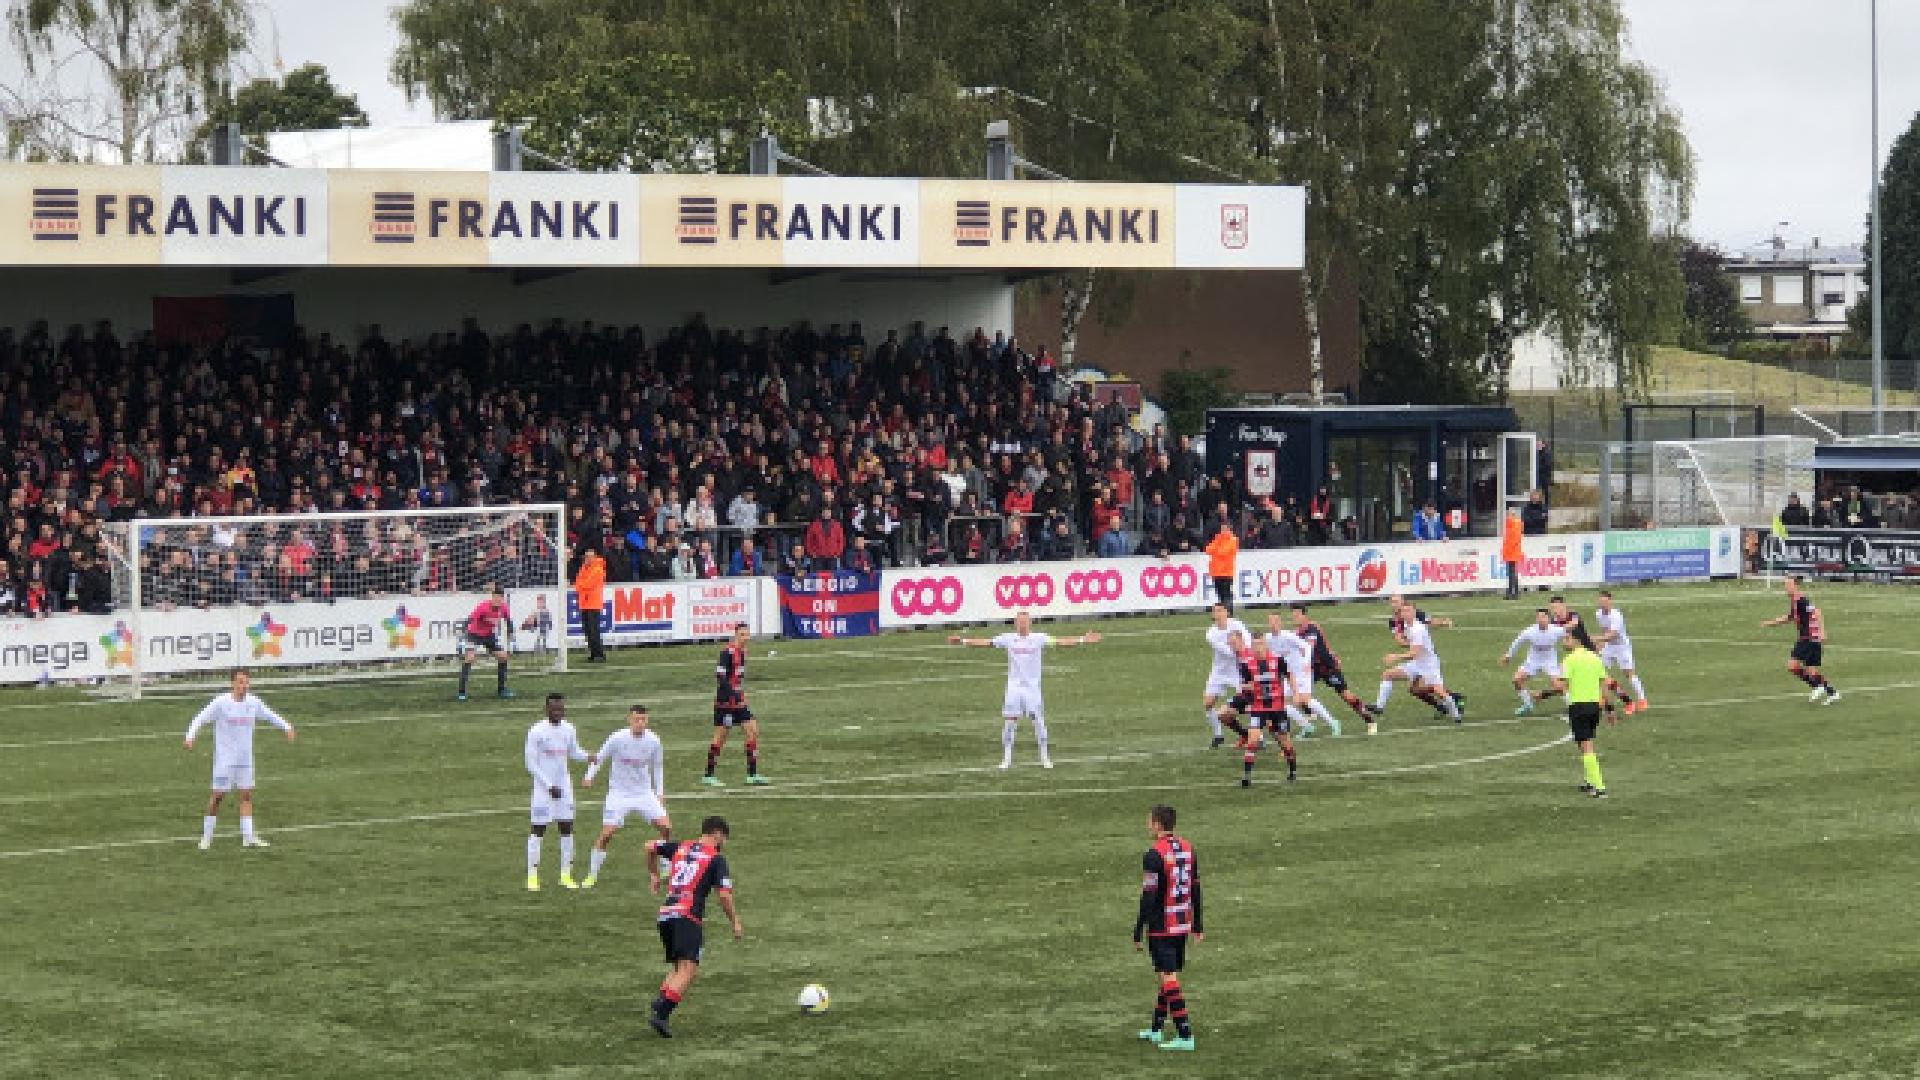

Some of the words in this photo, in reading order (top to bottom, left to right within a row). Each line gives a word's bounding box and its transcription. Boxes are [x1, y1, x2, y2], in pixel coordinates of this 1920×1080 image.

[95, 194, 306, 236] FRANKI
[428, 200, 619, 239] FRANKI
[731, 203, 901, 241] FRANKI
[1001, 206, 1158, 244] FRANKI
[792, 575, 858, 591] SERGIO
[812, 599, 838, 613] ON
[293, 625, 373, 654] mega
[800, 617, 847, 634] TOUR
[3, 641, 88, 670] mega
[149, 632, 232, 662] mega
